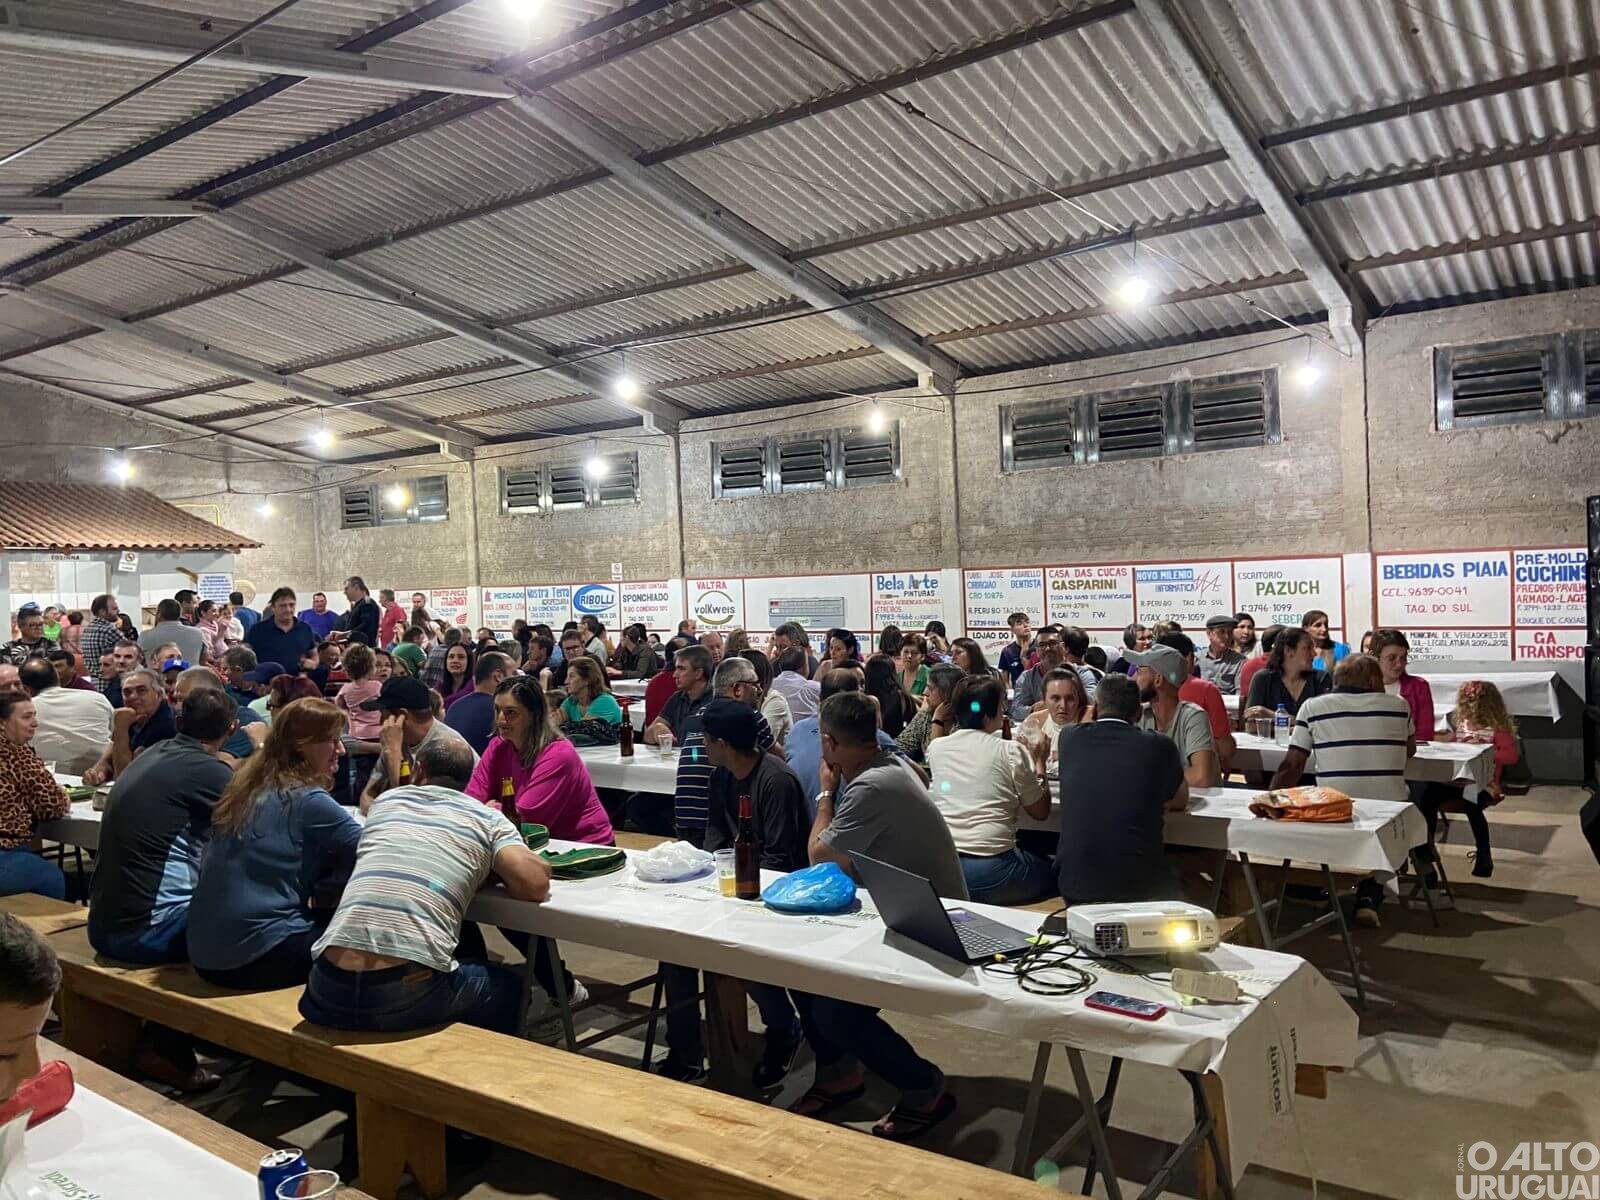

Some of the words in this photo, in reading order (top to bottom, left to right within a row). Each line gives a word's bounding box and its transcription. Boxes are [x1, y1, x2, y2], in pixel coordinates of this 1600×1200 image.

[1049, 570, 1070, 578] CASA
[1074, 568, 1092, 577] DAS
[1098, 568, 1128, 576] CUCAS
[1136, 571, 1158, 580] NOVO
[1160, 570, 1193, 580] MILENIO
[1383, 563, 1455, 580] BEBIDAS
[1462, 561, 1508, 578] PIAIA
[696, 581, 728, 590] VALTRA
[876, 574, 904, 590] Bela
[908, 574, 938, 590] Arte
[1010, 580, 1041, 588] DENTISTA
[1052, 579, 1117, 590] GASPARINI
[1256, 580, 1320, 596] PAZUCH
[1408, 586, 1468, 596] 9639-0041
[622, 592, 669, 603] SPONCHIADO
[1432, 604, 1446, 612] DO
[1452, 604, 1472, 612] SUL
[1534, 632, 1557, 644] GA
[1518, 645, 1586, 659] TRANSPO
